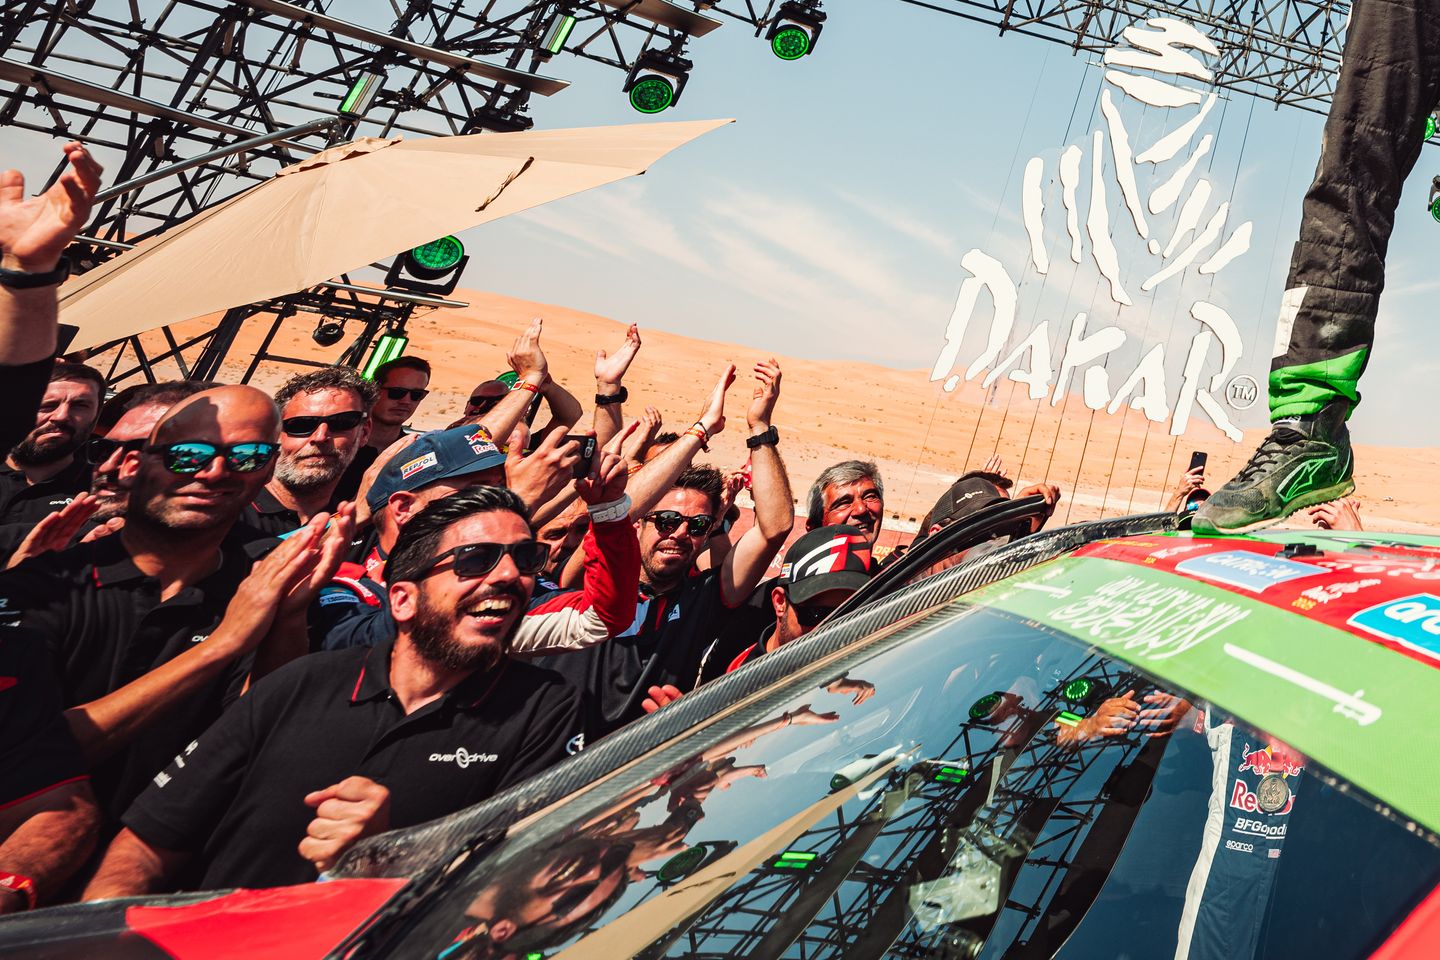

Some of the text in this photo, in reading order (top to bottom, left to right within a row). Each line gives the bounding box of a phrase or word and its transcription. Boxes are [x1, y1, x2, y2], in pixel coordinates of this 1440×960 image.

[929, 248, 1244, 442] DAKAR
[402, 456, 434, 475] REPSOL
[1233, 817, 1288, 839] BFGood
[1225, 839, 1254, 853] sparco
